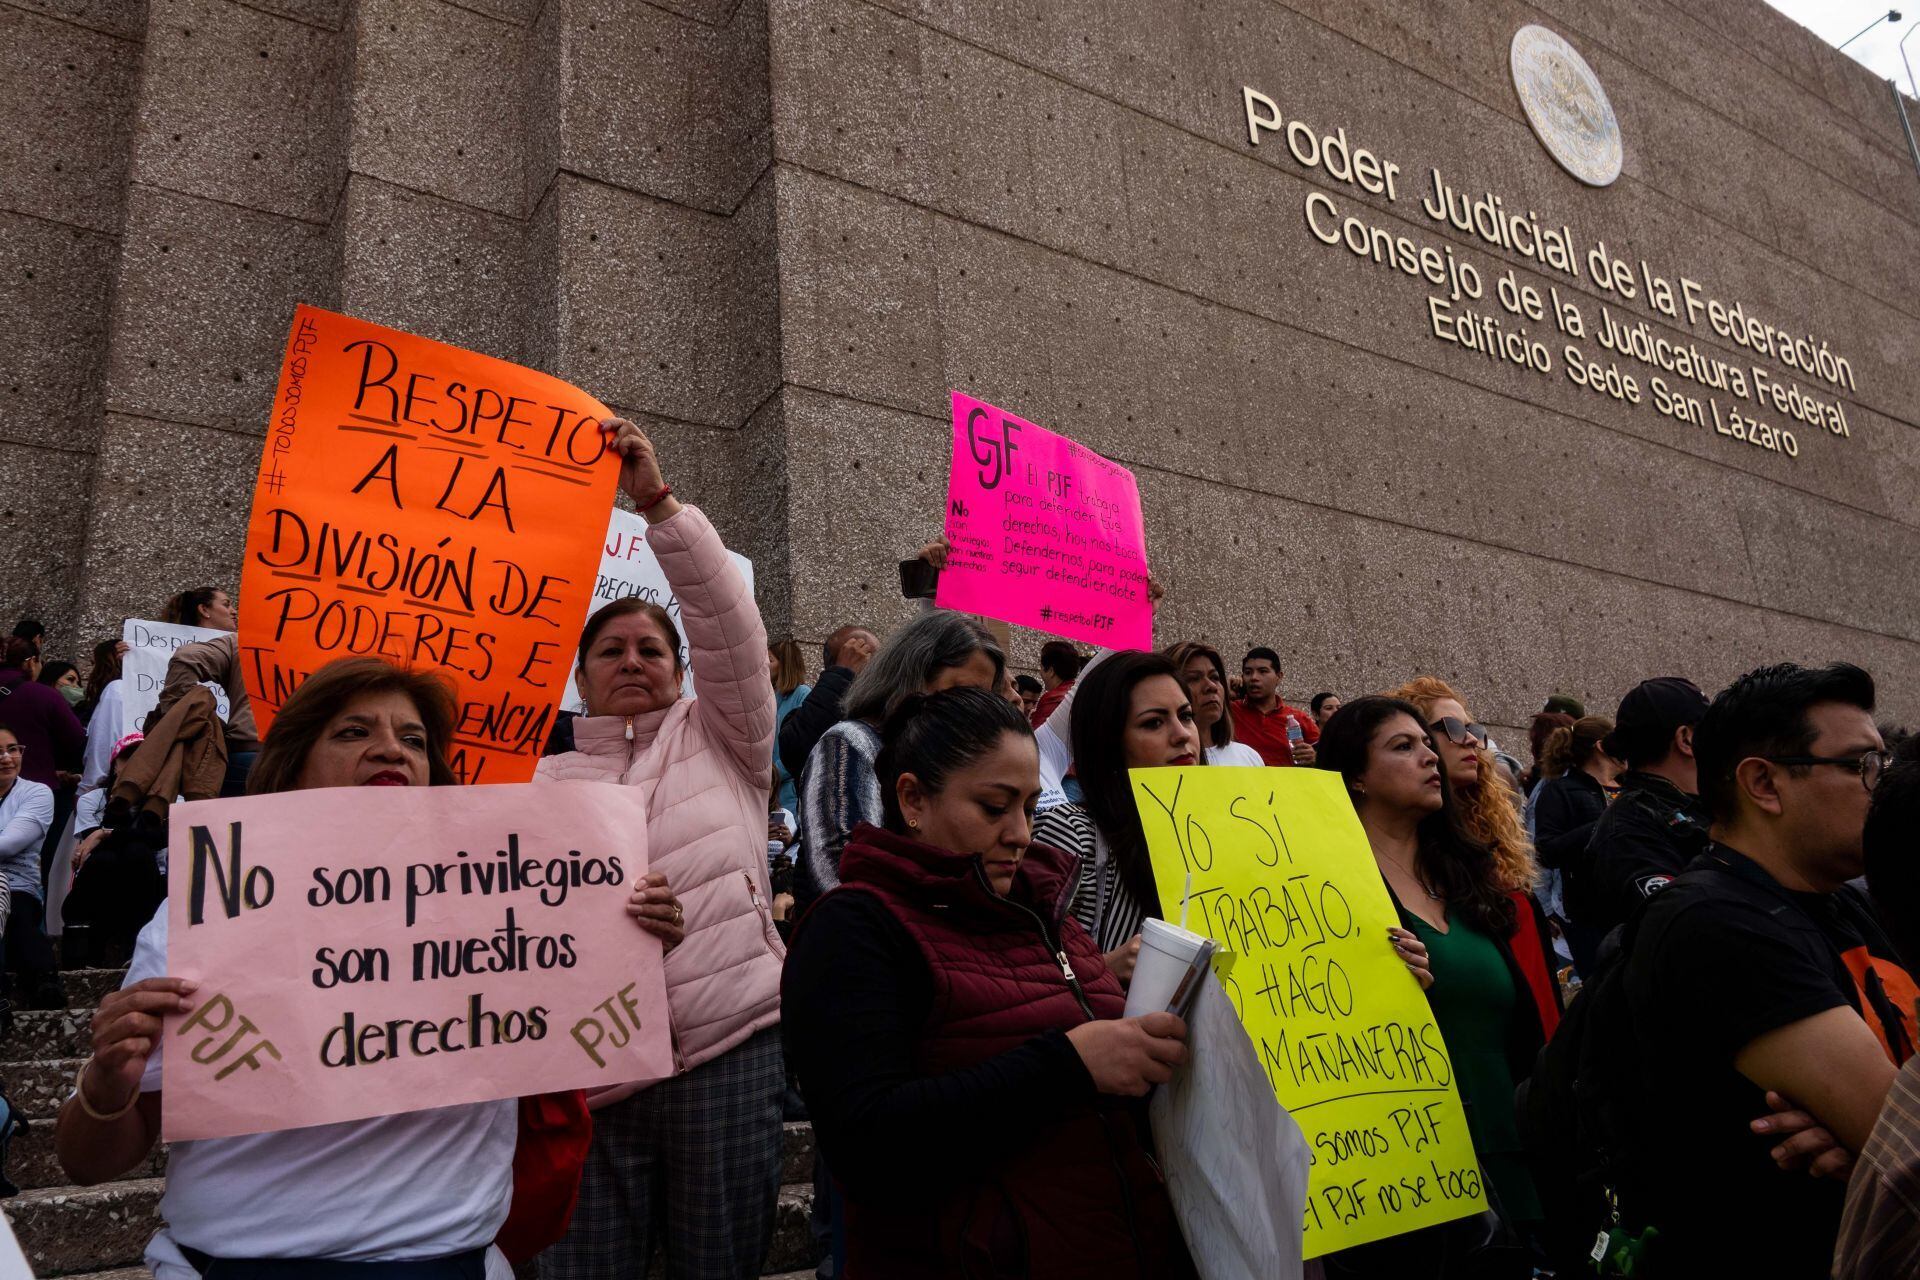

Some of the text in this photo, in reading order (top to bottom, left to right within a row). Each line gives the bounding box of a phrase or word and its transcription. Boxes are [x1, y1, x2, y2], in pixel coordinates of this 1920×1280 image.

[1243, 86, 1856, 391] Poder Judicial de la Federación
[1305, 192, 1850, 437] Consejo de la Judicatura Federal
[343, 340, 608, 467] RESPETO
[1428, 296, 1798, 457] Edificio Sede San Lázaro
[351, 443, 516, 534] A LA
[951, 499, 970, 517] No
[1004, 490, 1122, 533] para defender tus
[1047, 469, 1072, 499] PJF
[1079, 479, 1120, 520] trabaja
[257, 508, 570, 628] DIVISIÓN DE
[1001, 560, 1036, 578] seguir
[1065, 523, 1088, 552] hoy
[1090, 537, 1112, 553] nos
[1088, 559, 1115, 577] para
[264, 587, 561, 688] PODERES E
[187, 821, 624, 927] No son privilegios
[312, 906, 577, 989] son nuestros
[570, 982, 643, 1068] PJF
[1255, 955, 1353, 1021] HAGO
[176, 993, 282, 1082] PJF
[320, 993, 550, 1067] derechos
[1261, 1022, 1450, 1093] MAÑANERAS
[1387, 1102, 1443, 1154] PJF
[1322, 1178, 1368, 1226] PJF
[1378, 1184, 1402, 1215] no
[1400, 1176, 1432, 1209] se
[1430, 1160, 1481, 1200] toca
